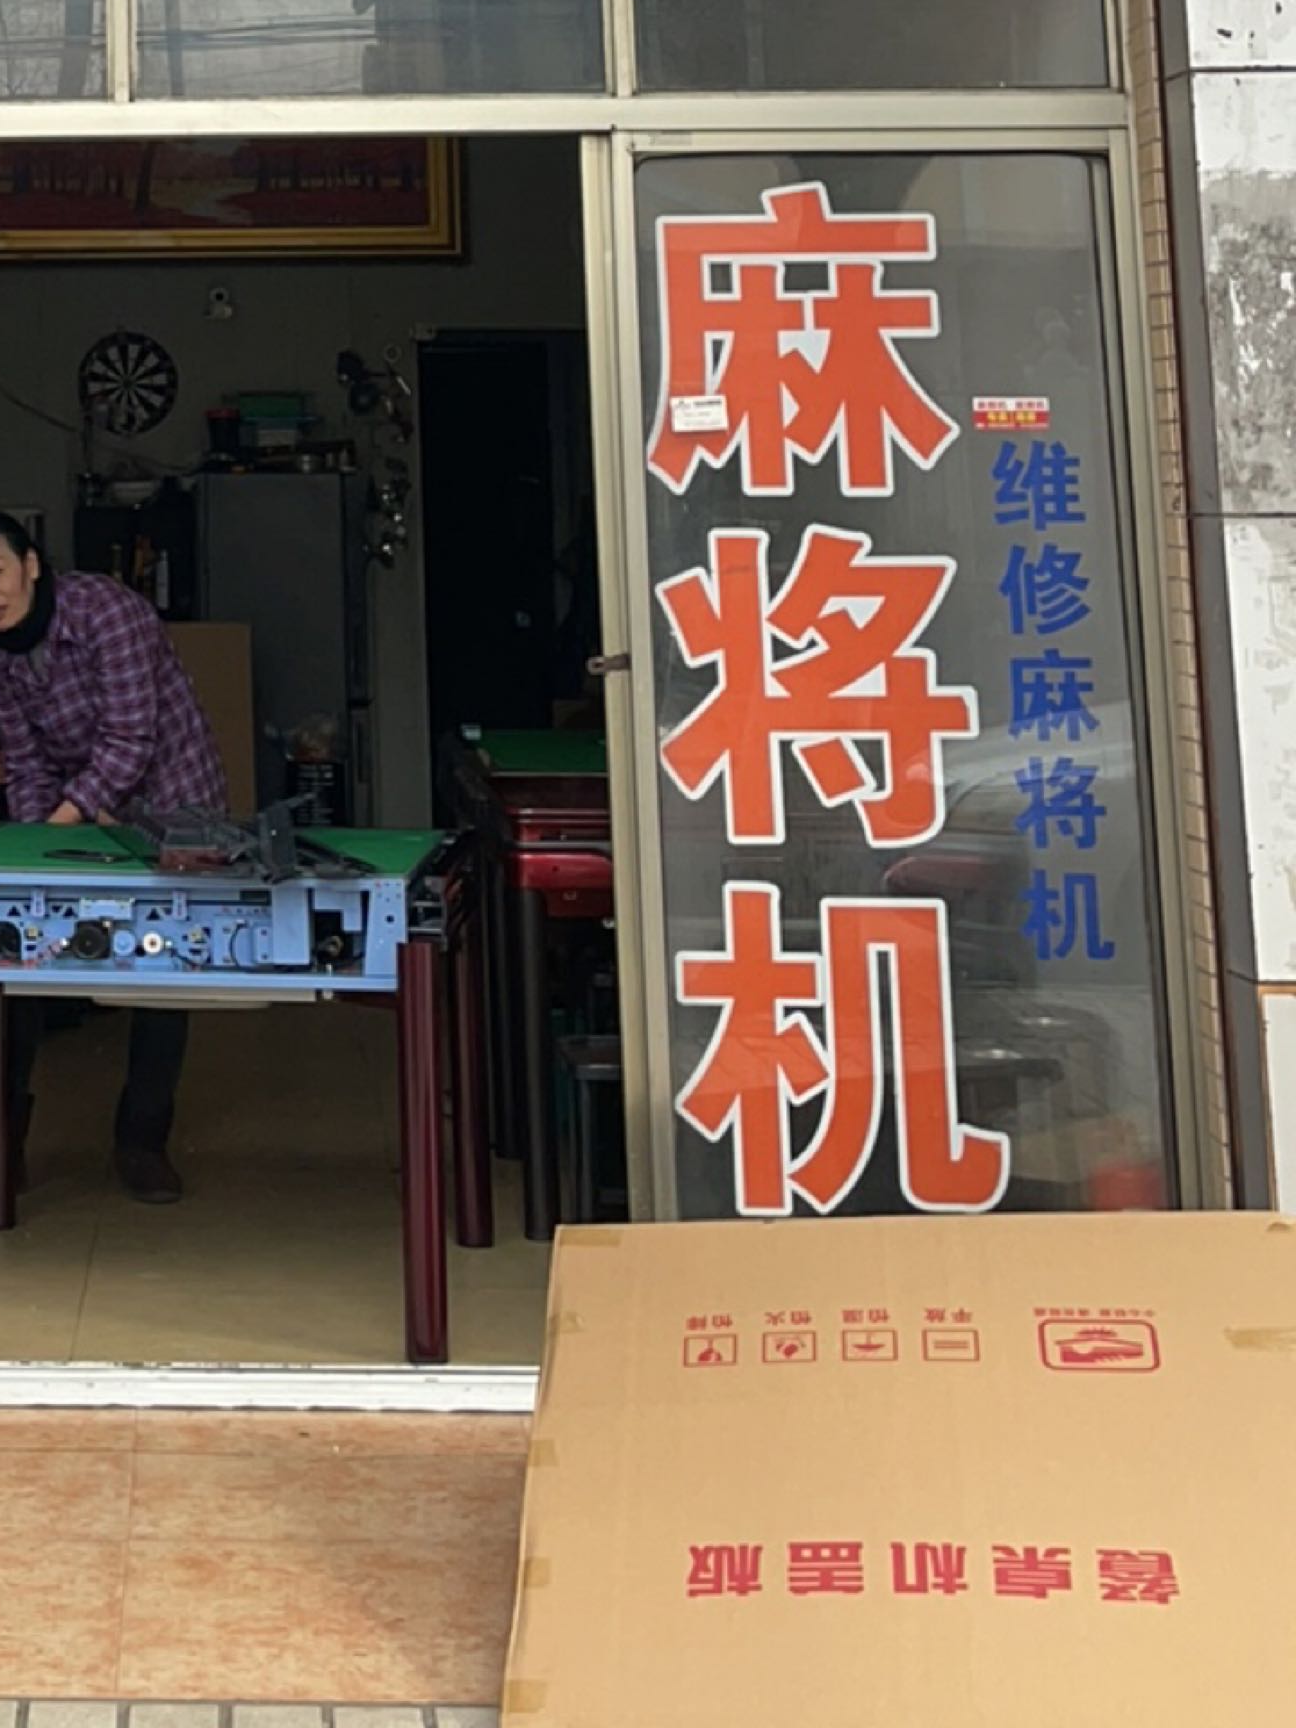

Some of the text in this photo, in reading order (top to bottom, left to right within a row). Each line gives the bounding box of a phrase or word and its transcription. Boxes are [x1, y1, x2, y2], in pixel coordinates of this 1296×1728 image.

[645, 181, 1009, 1216] 麻将机
[992, 440, 1116, 962] 维修麻将机
[686, 1541, 1181, 1604] 餐桌机盖板
